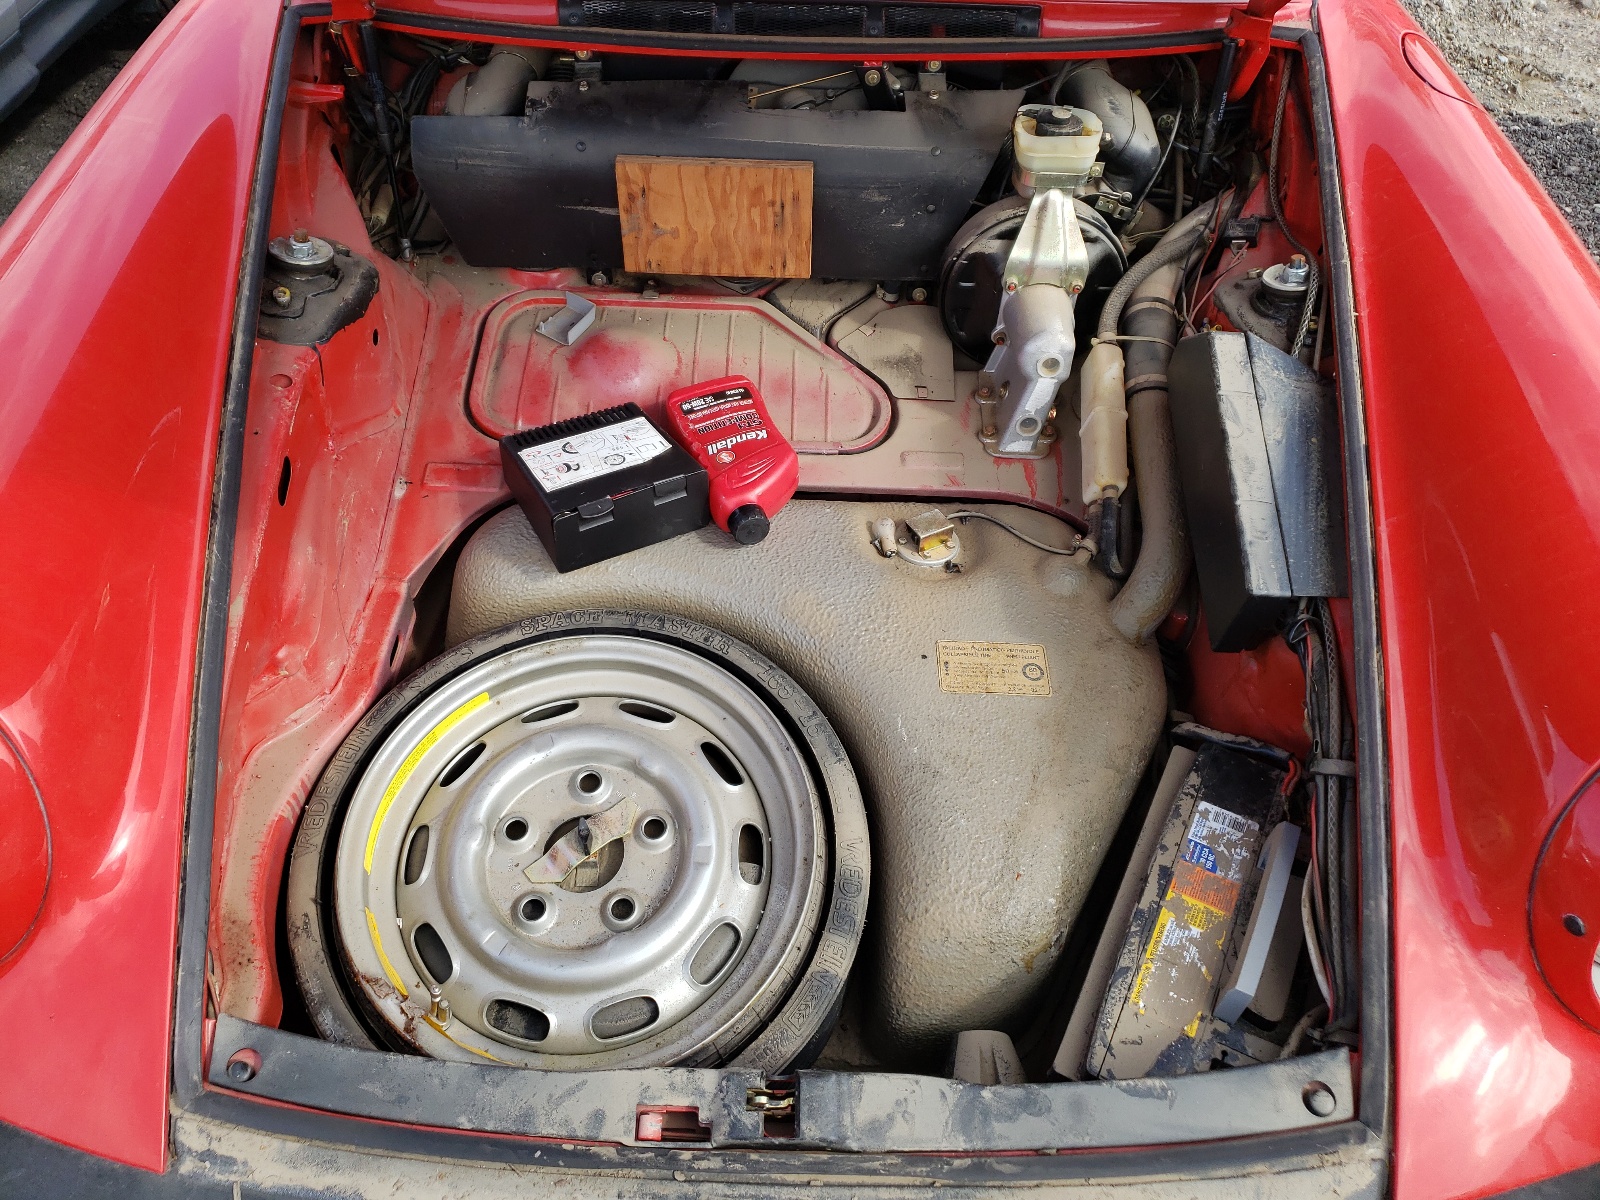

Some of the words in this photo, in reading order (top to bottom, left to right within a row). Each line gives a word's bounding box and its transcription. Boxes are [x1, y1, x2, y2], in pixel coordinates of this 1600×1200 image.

[697, 412, 760, 435] COMPETITION
[706, 429, 769, 456] Kendall
[520, 608, 604, 636] SPACE
[622, 610, 735, 656] MASTER
[293, 725, 373, 861] VREDESTEIN
[1201, 848, 1210, 858] CCA
[811, 836, 864, 990] VREDESTEIN
